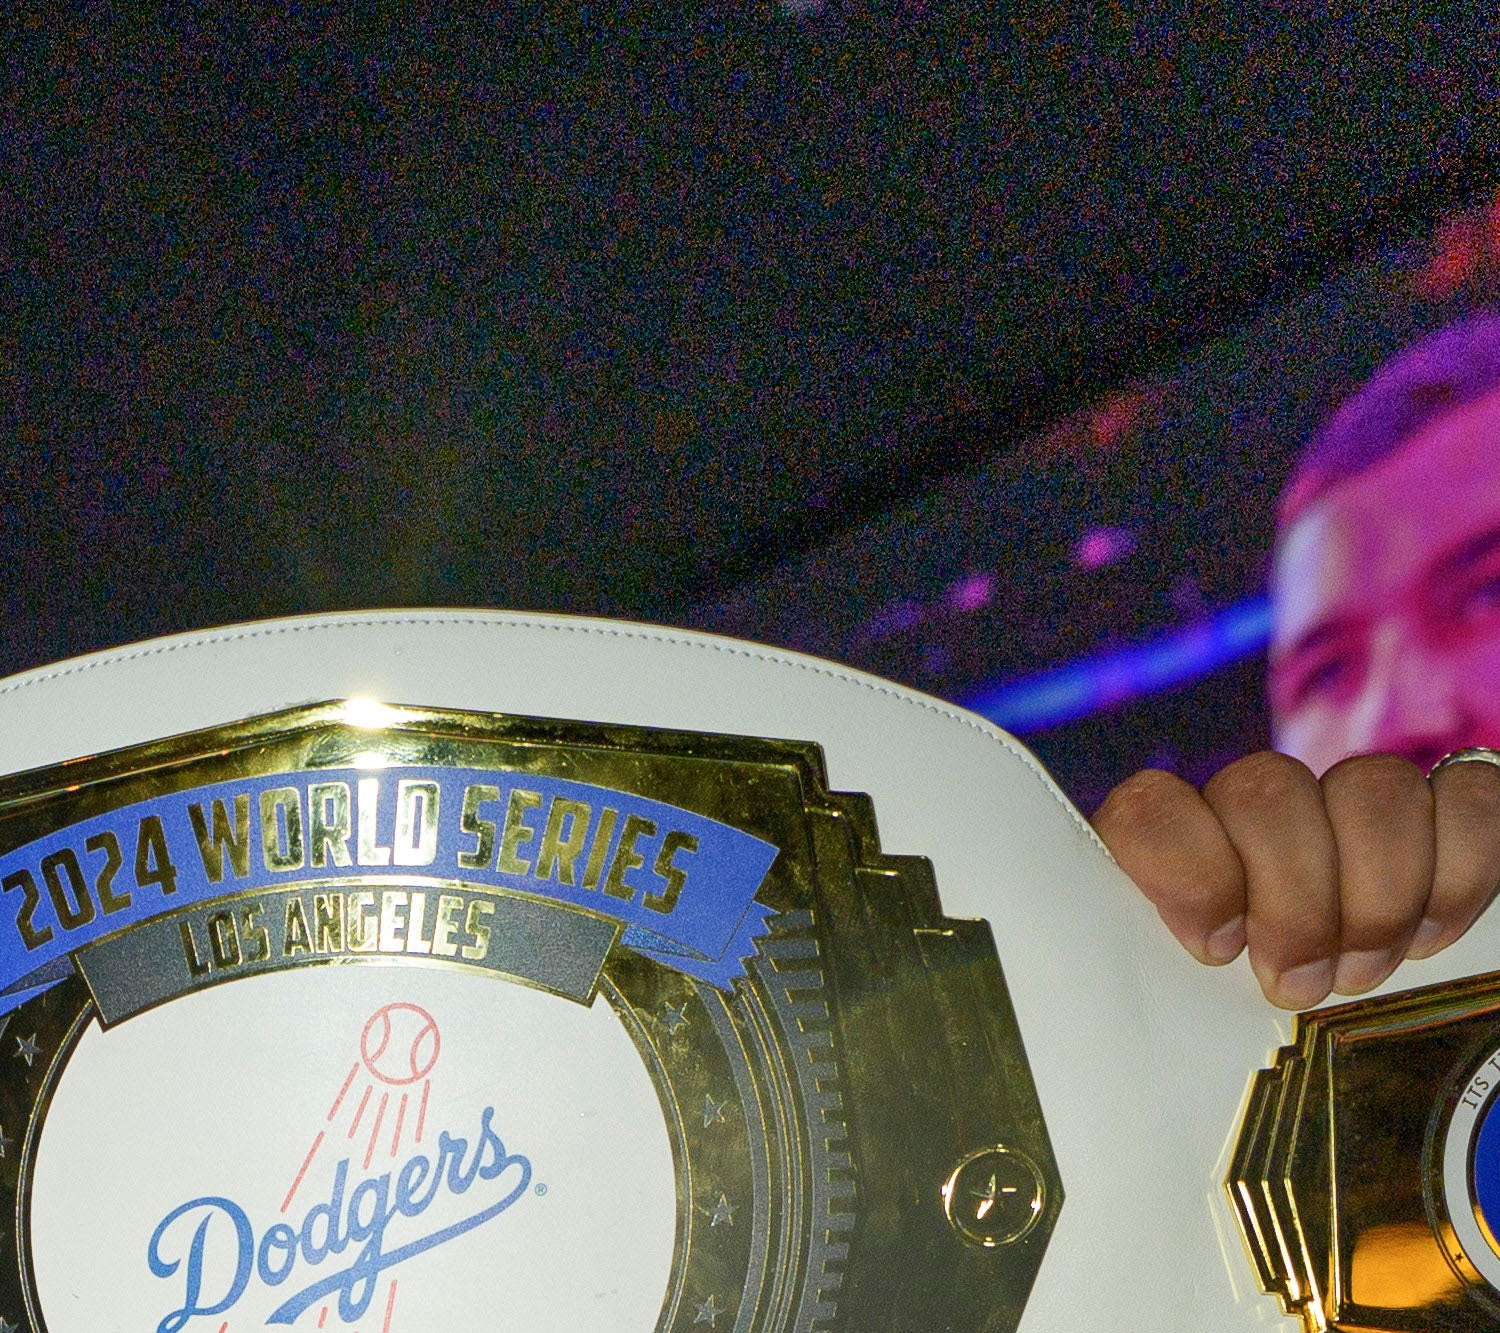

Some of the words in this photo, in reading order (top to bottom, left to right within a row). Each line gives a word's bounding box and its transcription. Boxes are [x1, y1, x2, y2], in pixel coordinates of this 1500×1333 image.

[1, 815, 177, 952] 2024
[188, 779, 441, 884] WORLD
[457, 785, 700, 915] SERIES
[181, 915, 272, 979] LOS
[284, 890, 496, 960] ANGELES
[1461, 1076, 1490, 1110] ITS
